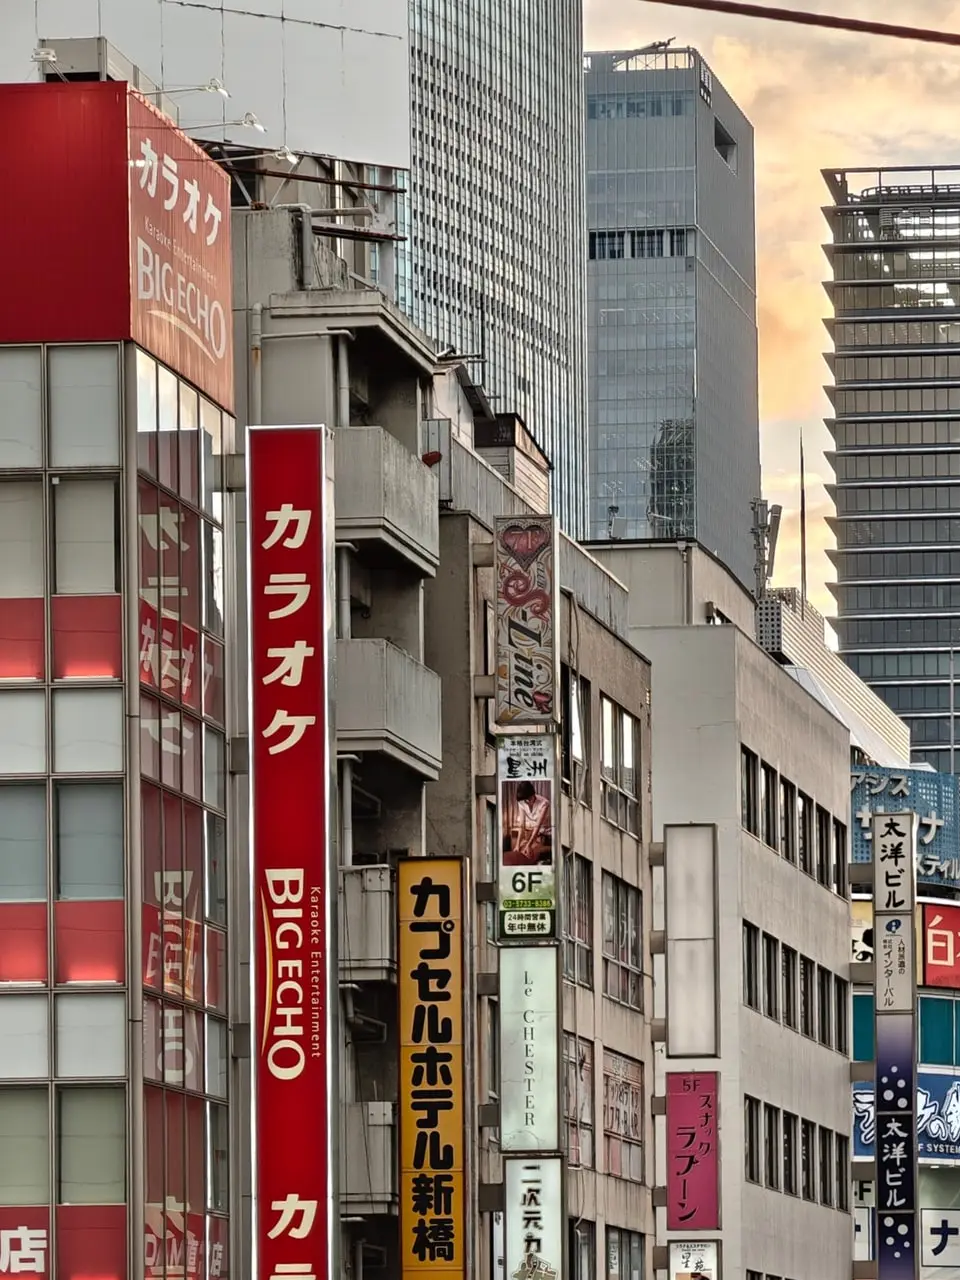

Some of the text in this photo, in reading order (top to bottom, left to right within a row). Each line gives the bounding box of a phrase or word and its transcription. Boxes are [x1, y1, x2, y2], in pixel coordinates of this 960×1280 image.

[139, 137, 222, 246] カラオケ
[137, 236, 227, 359] BIG ECHO
[262, 503, 316, 755] カラオケ
[511, 872, 543, 893] 6F
[880, 818, 906, 909] 太洋ビル
[265, 868, 306, 1080] BIG ECHO
[310, 886, 321, 1058] Karaoke Entertainment
[507, 923, 547, 932] 年中無休
[409, 875, 455, 1262] カプセルホテル新橋
[523, 971, 535, 1126] Le CHESTER
[683, 1079, 701, 1092] 5F
[698, 1095, 713, 1157] スナック
[882, 1118, 908, 1209] 太洋ビル
[0, 1226, 48, 1273] 店
